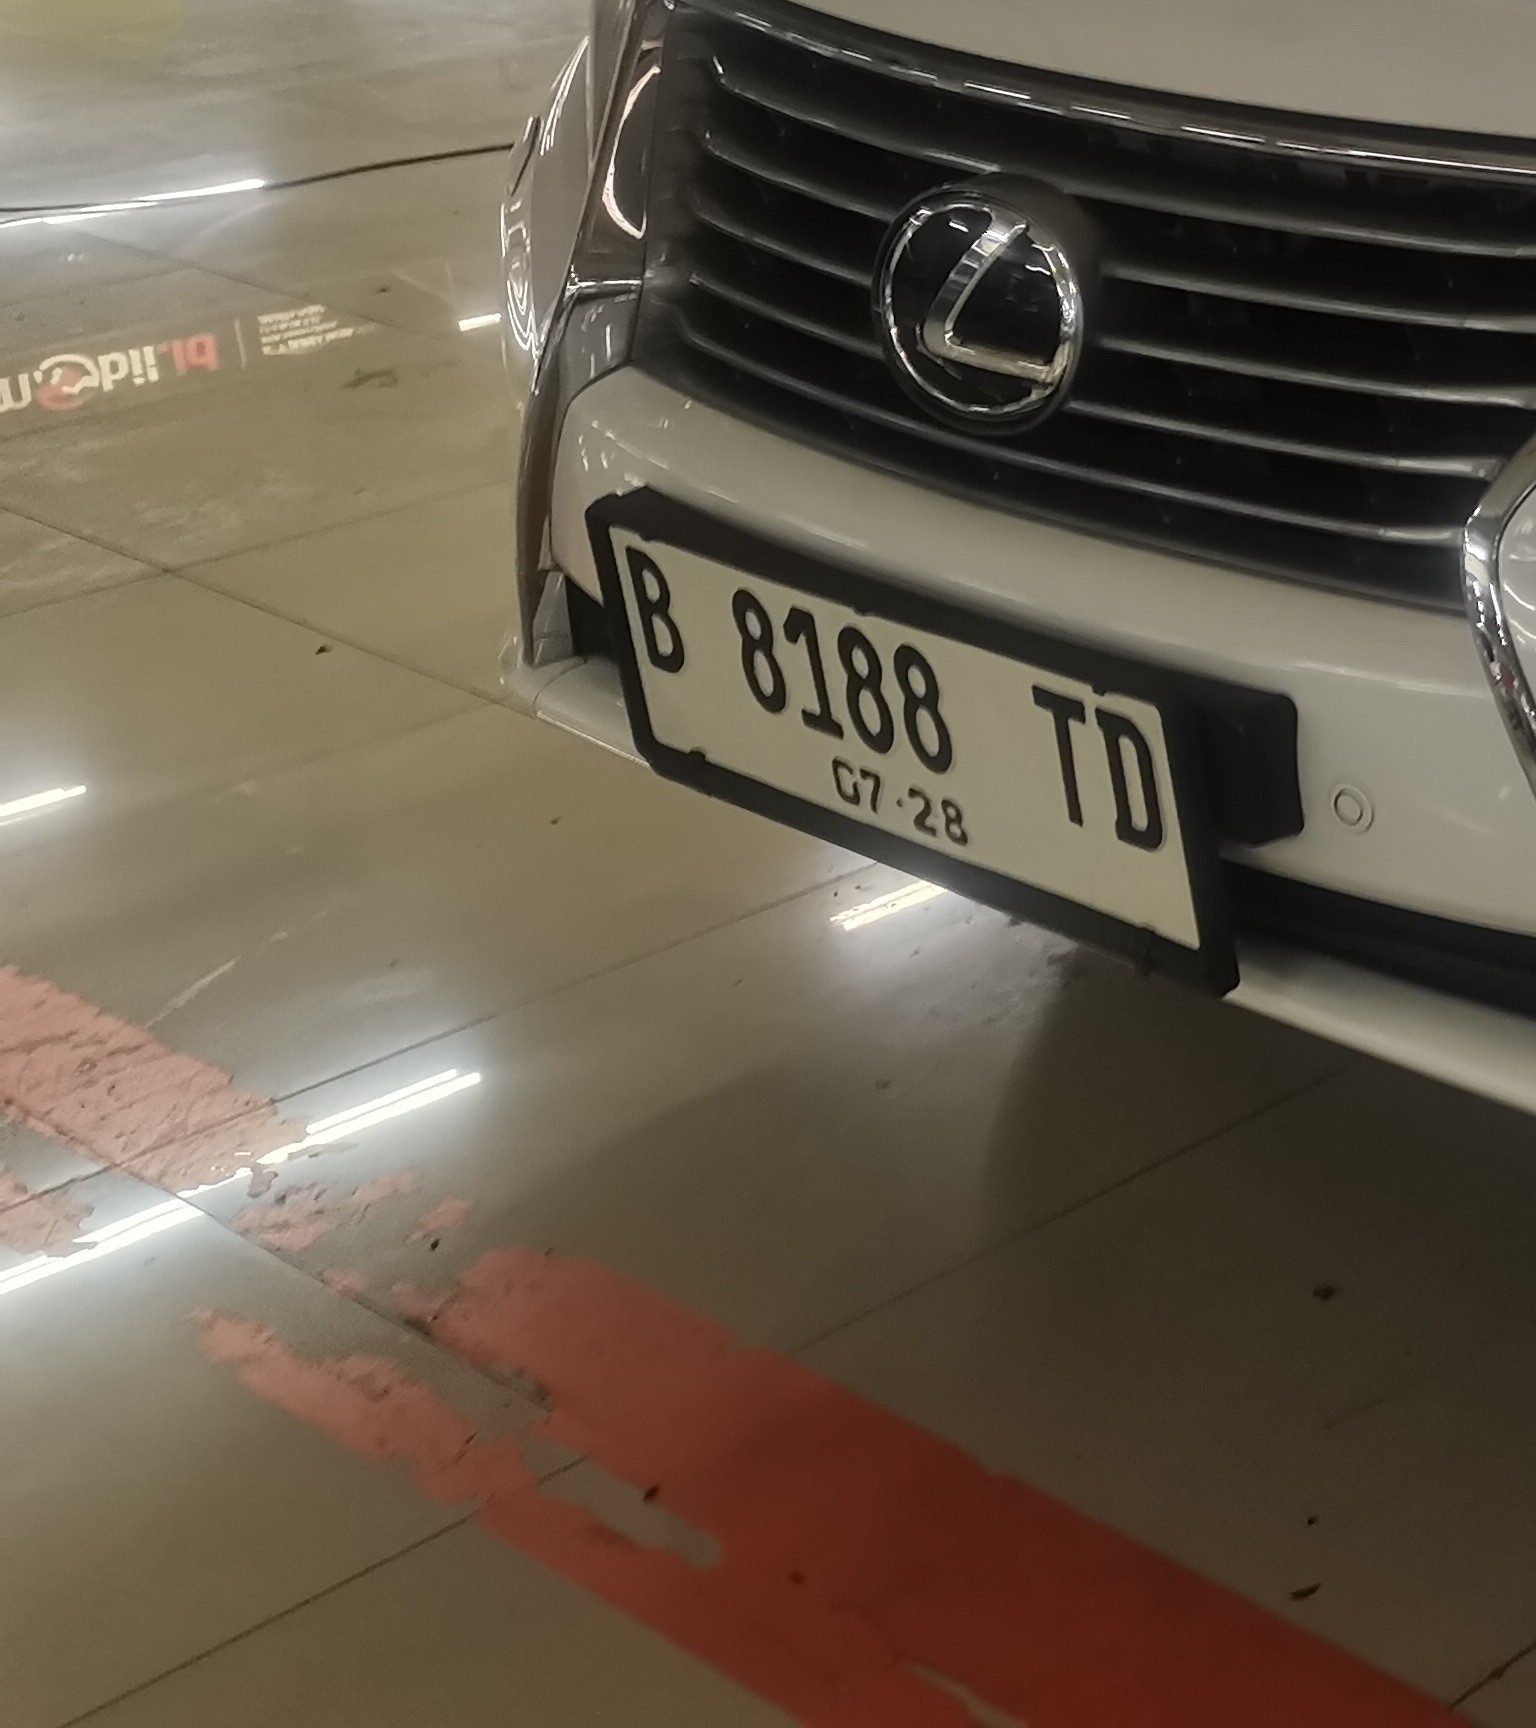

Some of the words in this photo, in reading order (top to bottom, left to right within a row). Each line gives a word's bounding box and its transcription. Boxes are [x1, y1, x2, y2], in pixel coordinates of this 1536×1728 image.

[625, 546, 685, 674] B
[731, 588, 953, 774] 8188
[1031, 684, 1163, 852] TD
